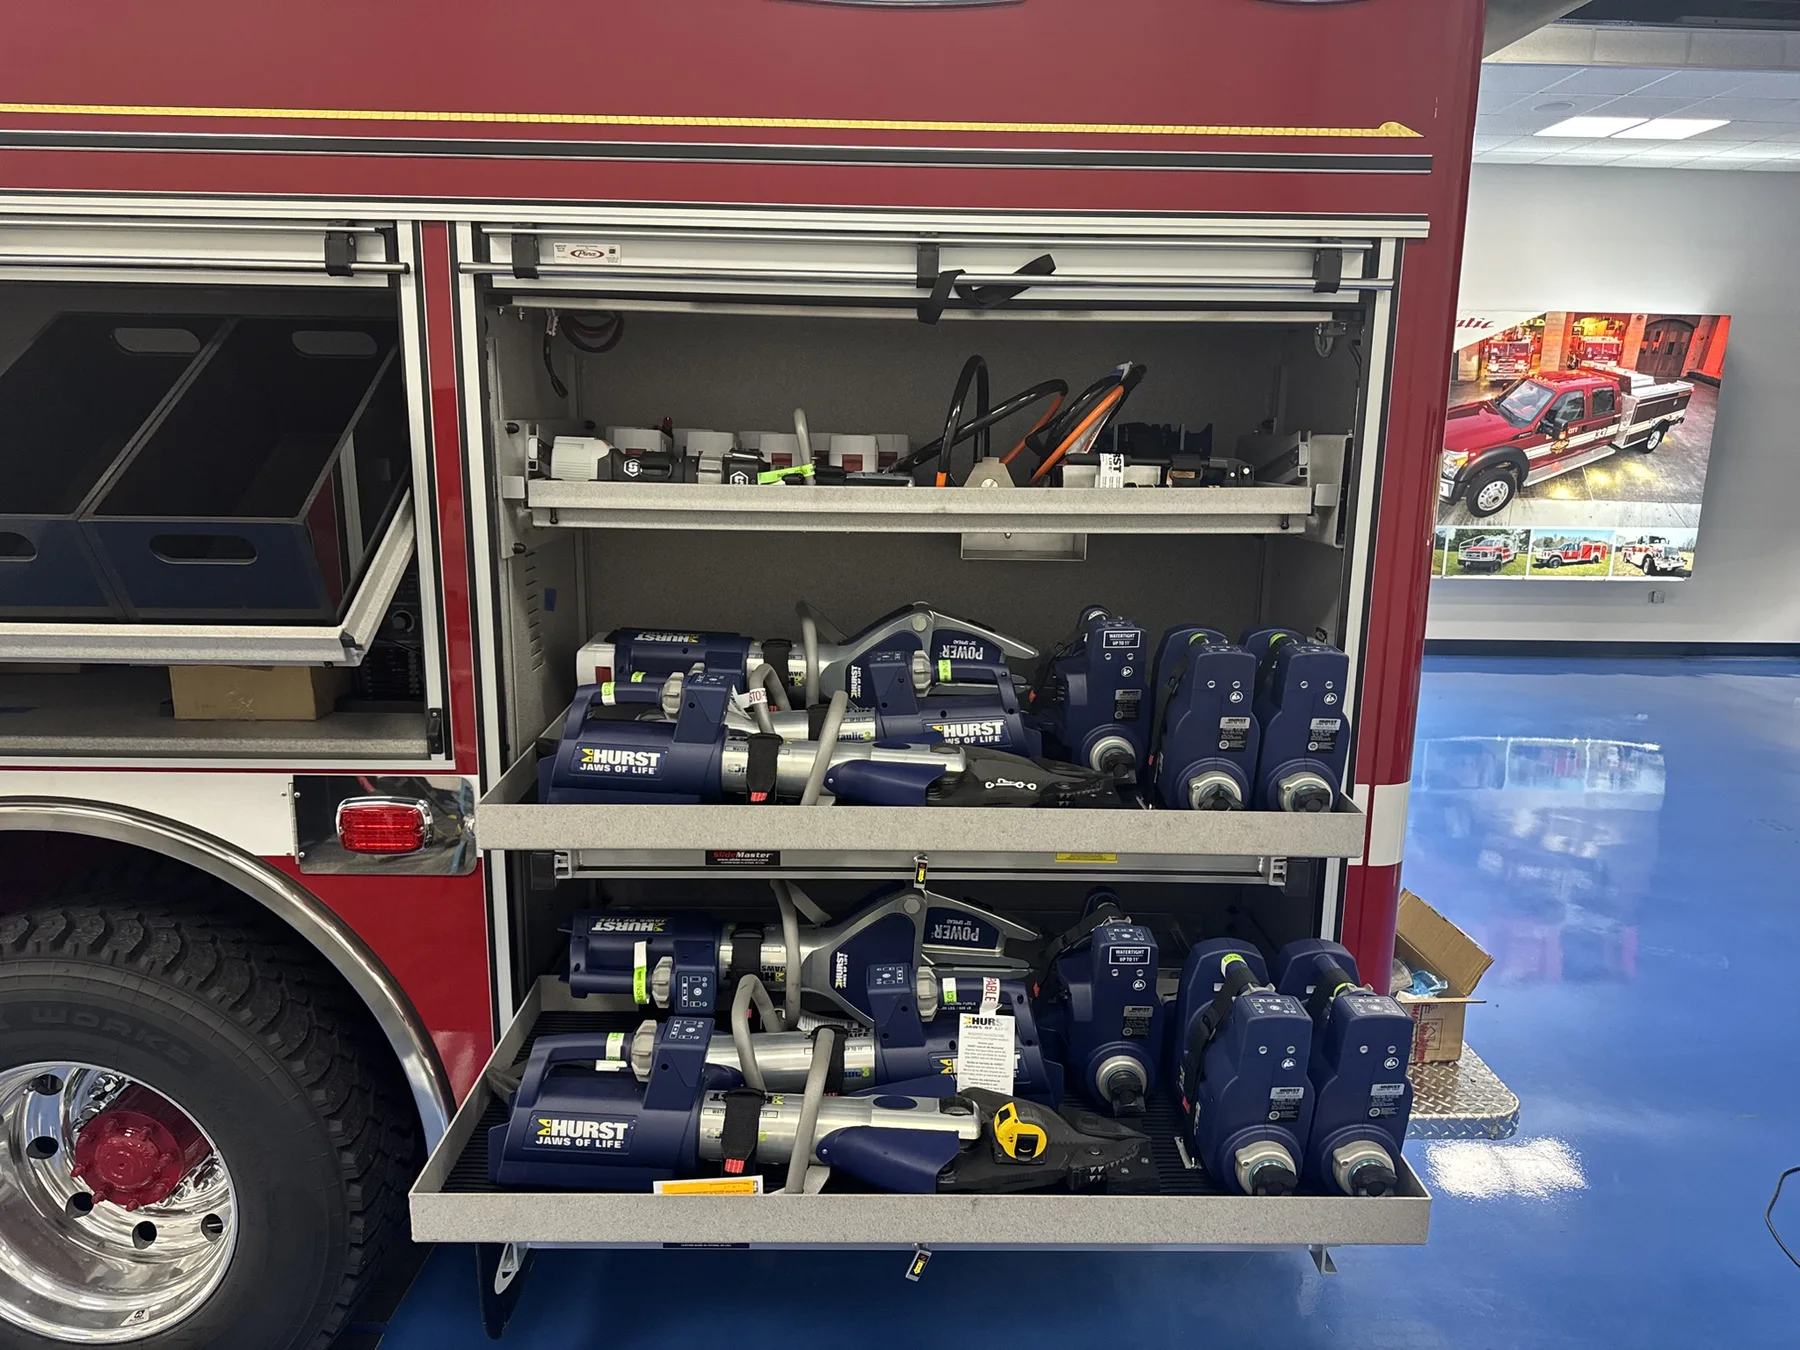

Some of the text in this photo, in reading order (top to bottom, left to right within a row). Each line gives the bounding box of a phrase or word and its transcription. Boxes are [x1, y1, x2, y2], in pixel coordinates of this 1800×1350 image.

[634, 633, 690, 642] HURST
[942, 645, 983, 660] POWER
[943, 722, 1004, 738] HURST
[979, 735, 1001, 743] LIFE
[593, 749, 661, 767] HURST
[579, 763, 656, 775] JAWS OF LIFE
[591, 922, 654, 931] HURST
[934, 924, 980, 942] POWER
[836, 952, 844, 981] HURST
[31, 1006, 193, 1066] WORKS
[551, 1119, 628, 1140] HURST
[535, 1136, 622, 1149] JAWS OF LIFE
